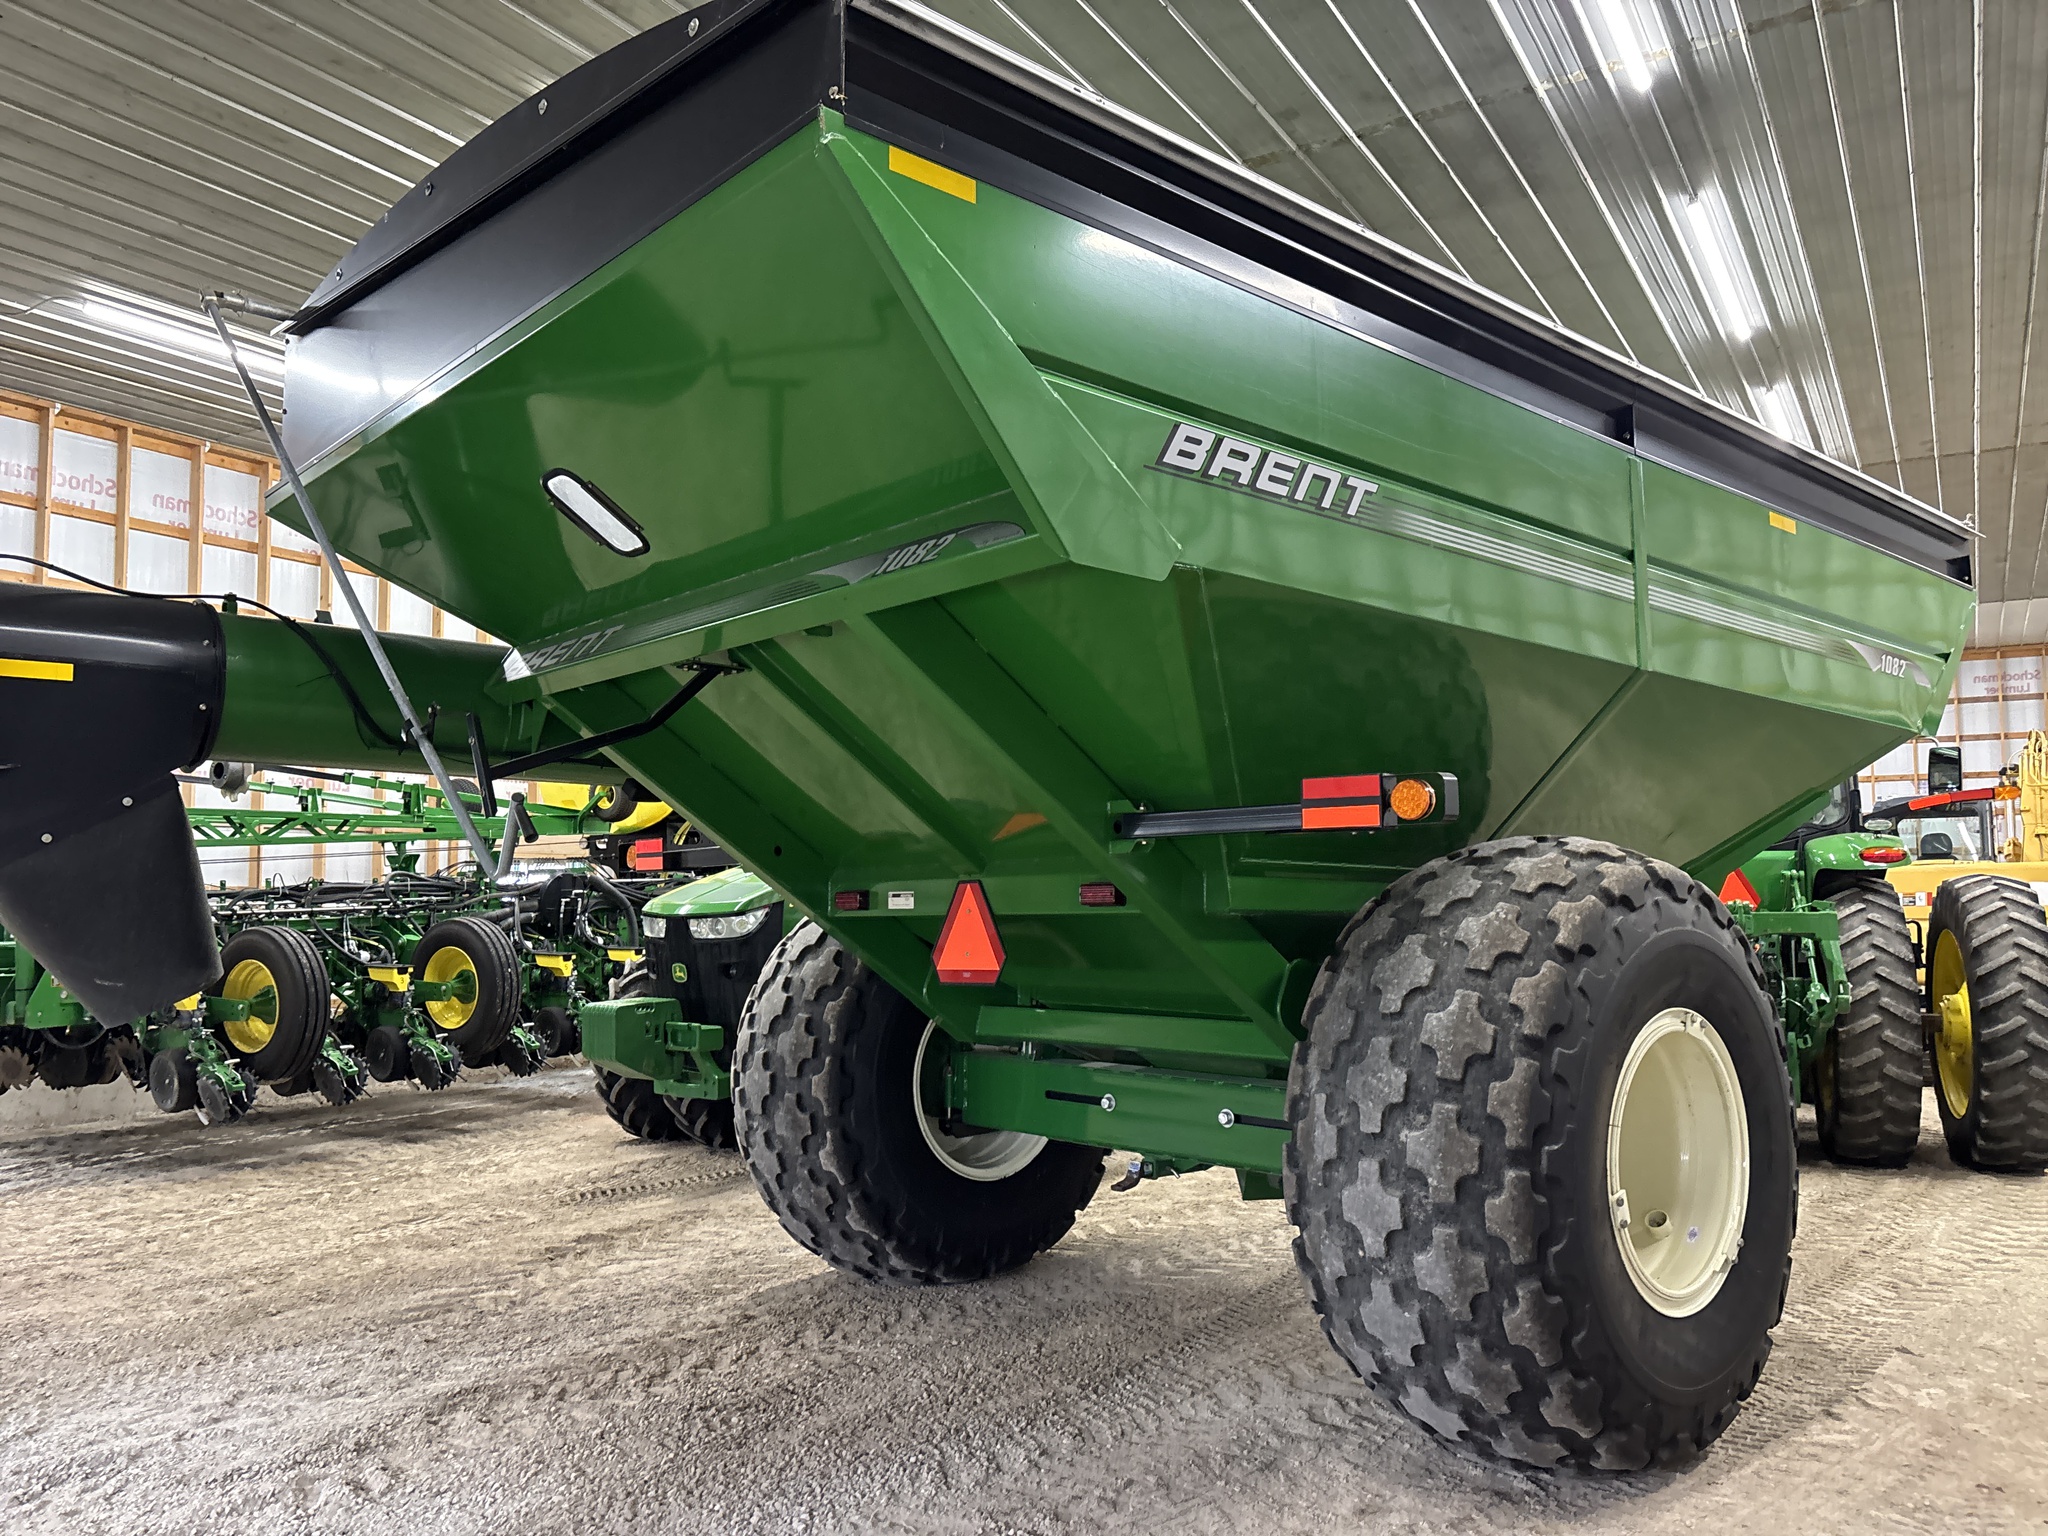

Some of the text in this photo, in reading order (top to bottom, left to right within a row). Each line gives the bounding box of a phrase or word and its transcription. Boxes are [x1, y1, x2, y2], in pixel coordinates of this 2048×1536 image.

[1156, 422, 1380, 517] BRENT
[873, 532, 957, 575] 1082
[1881, 653, 1906, 678] 1082
